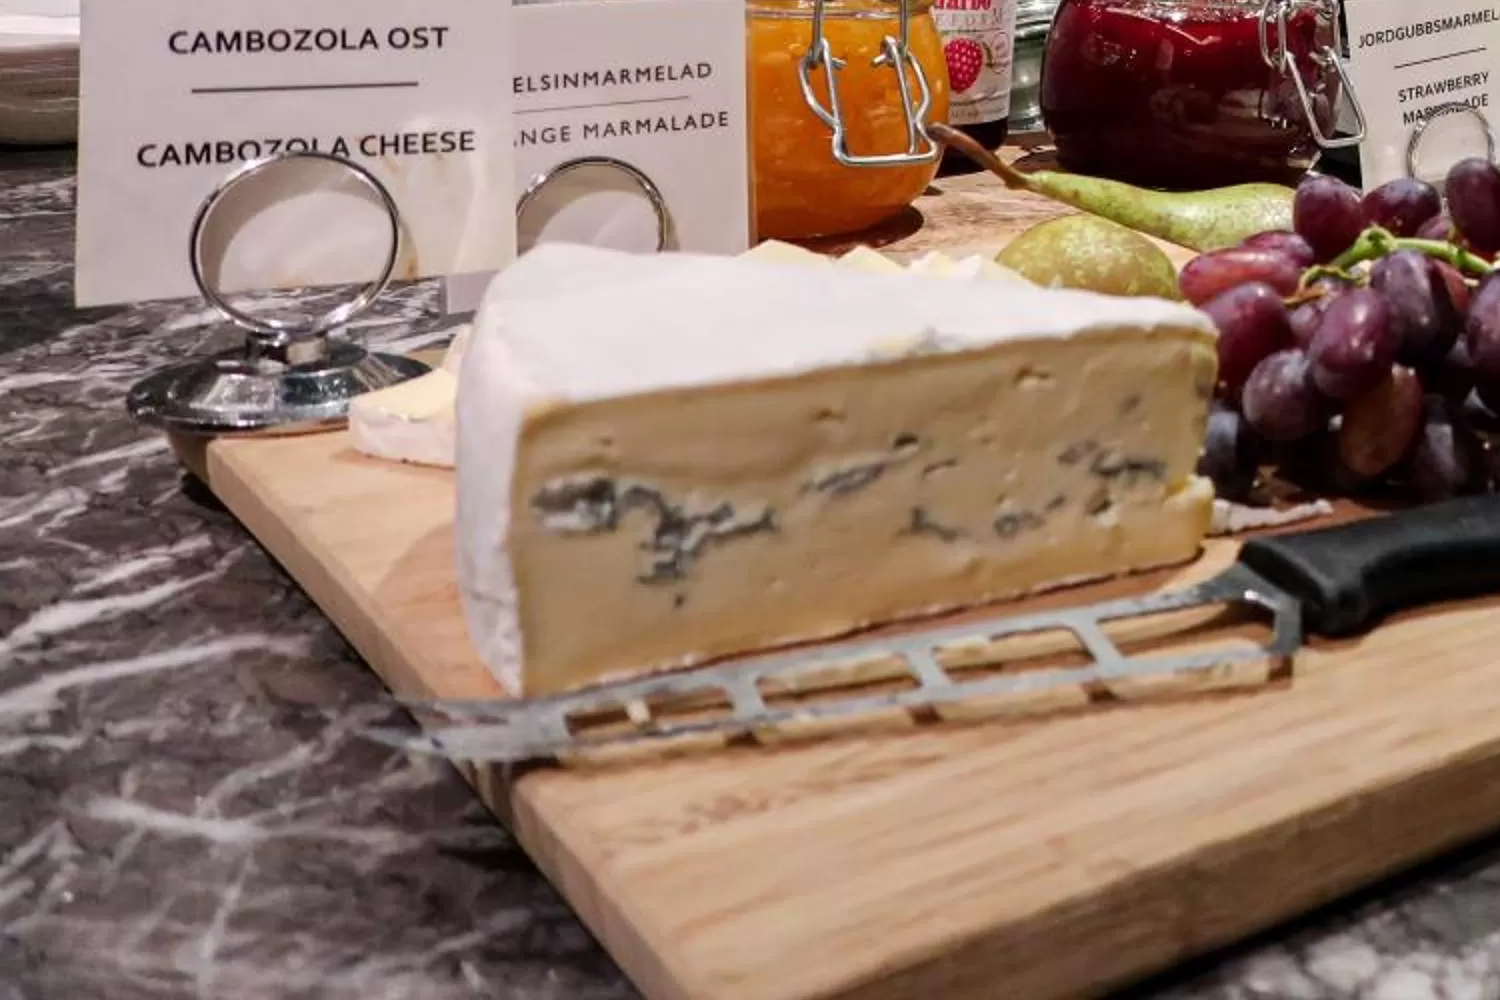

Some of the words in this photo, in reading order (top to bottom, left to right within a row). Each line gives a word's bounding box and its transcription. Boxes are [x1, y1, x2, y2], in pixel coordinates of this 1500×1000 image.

[168, 26, 378, 55] CAMBOZOLA
[387, 26, 449, 52] OST
[1398, 71, 1489, 103] STRAWBERRY
[582, 110, 729, 140] MARMALADE
[358, 129, 476, 158] CHEESE
